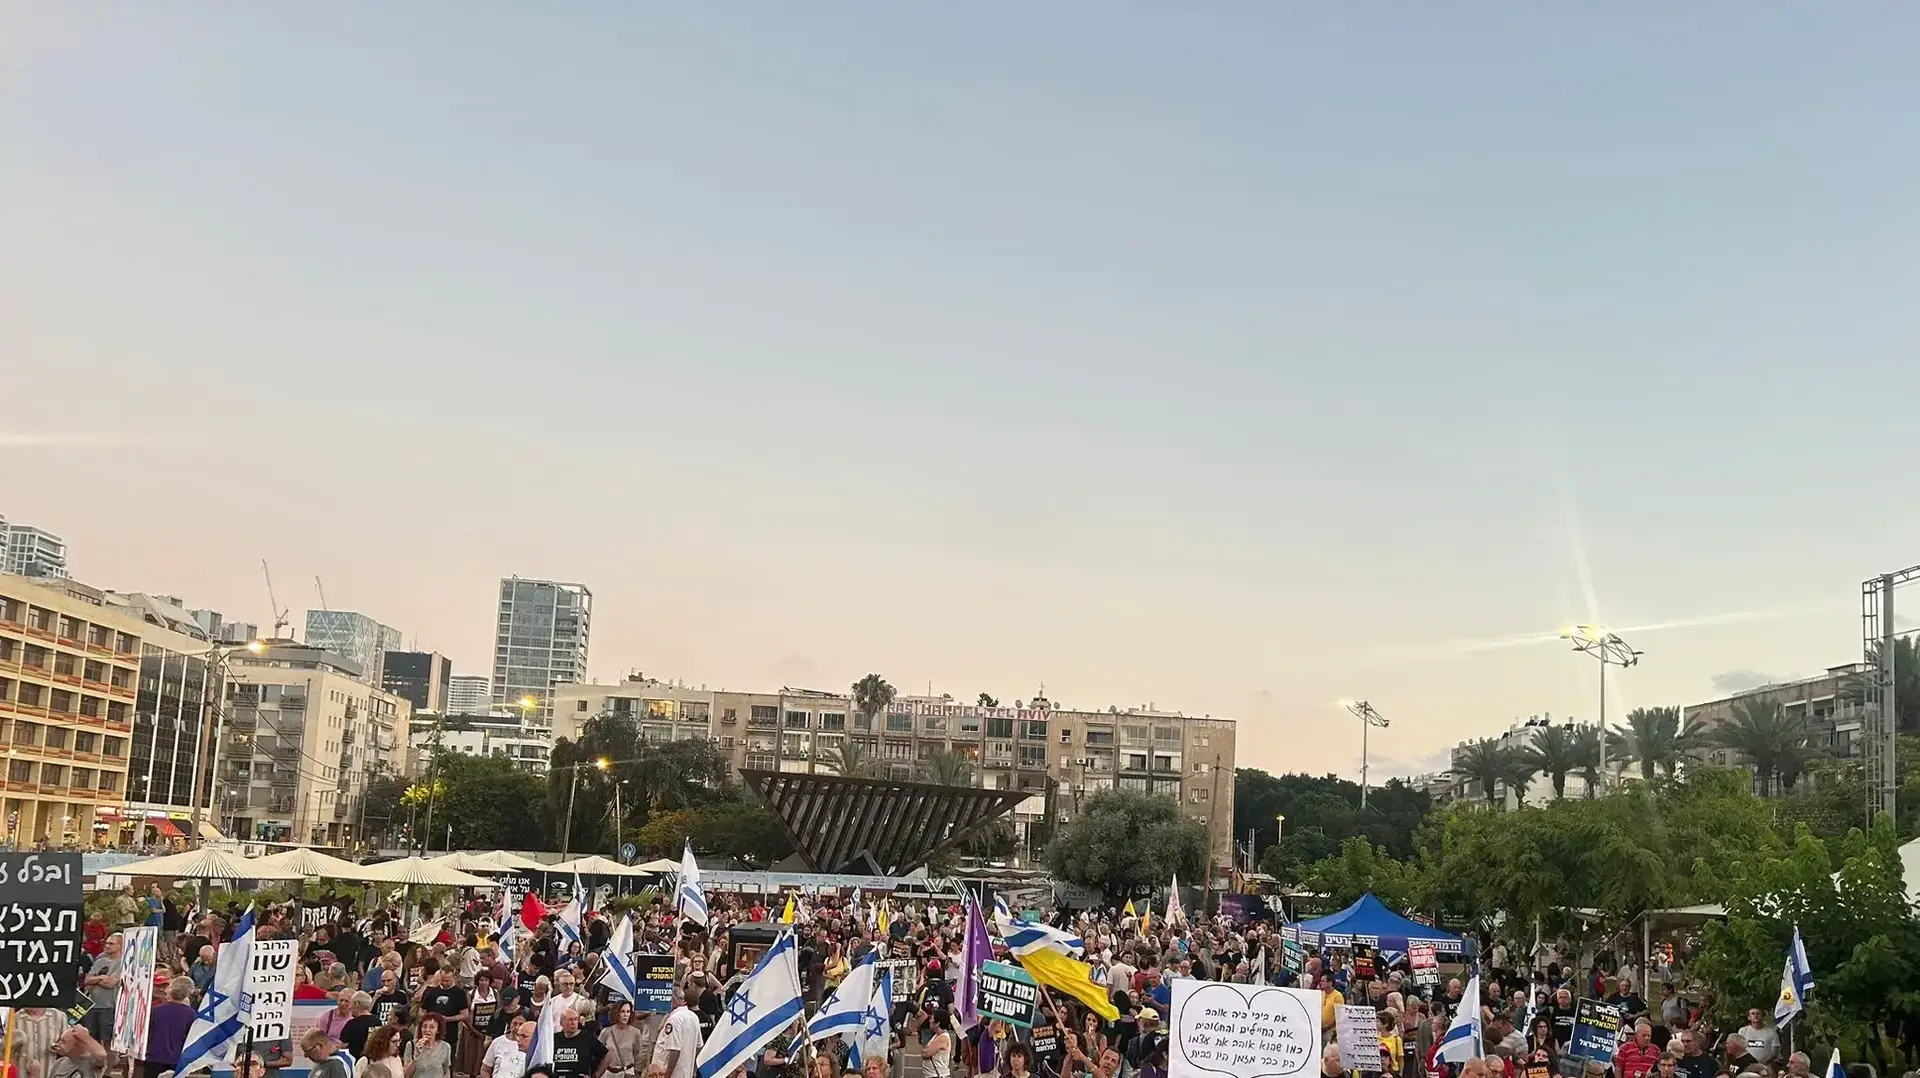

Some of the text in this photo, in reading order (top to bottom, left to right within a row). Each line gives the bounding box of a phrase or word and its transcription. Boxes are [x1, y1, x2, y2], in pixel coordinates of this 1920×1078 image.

[986, 707, 1015, 719] TEL
[1018, 710, 1049, 721] AVIV
[18, 855, 71, 885] ובכל
[262, 942, 290, 950] הרוב
[982, 975, 1035, 1001] כמה דם עוד
[983, 993, 1026, 1016] יישפך?
[256, 1011, 282, 1020] הרוב
[1239, 1022, 1275, 1037] החיילים
[1278, 1029, 1294, 1039] את
[1214, 1036, 1229, 1047] את
[1231, 1039, 1255, 1050] אוהב
[1579, 1038, 1601, 1050] ישראל
[1285, 1043, 1303, 1054] כמו
[1261, 1056, 1278, 1066] כבר
[1282, 1059, 1296, 1068] הם
